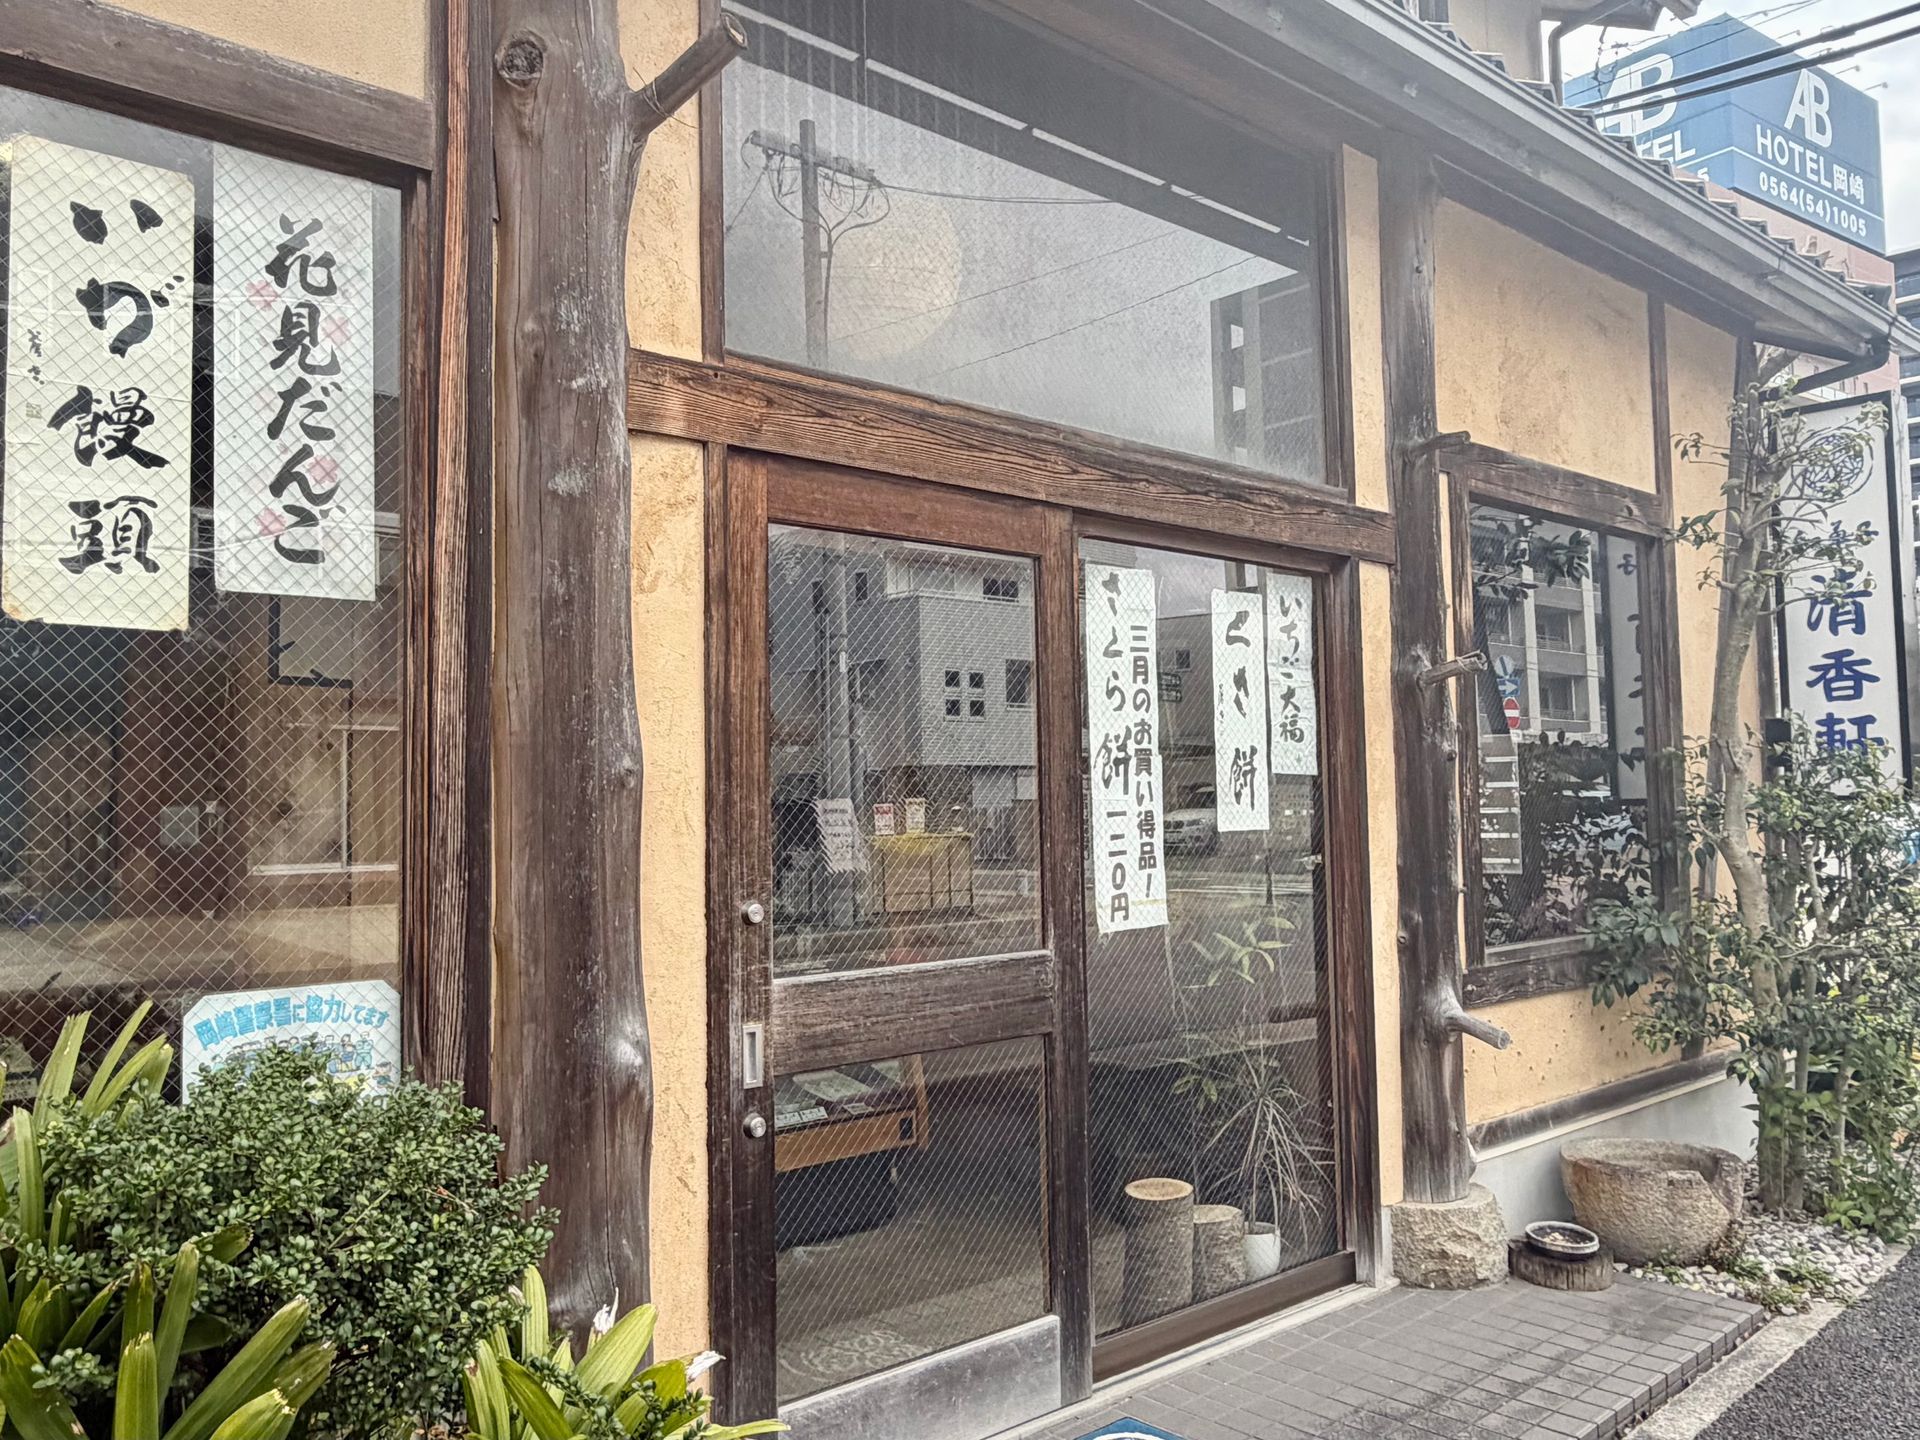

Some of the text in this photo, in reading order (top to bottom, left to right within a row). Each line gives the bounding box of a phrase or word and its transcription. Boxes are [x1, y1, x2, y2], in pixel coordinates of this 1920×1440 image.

[1637, 130, 1696, 164] TEL
[1784, 68, 1833, 148] AB
[1759, 171, 1867, 237] 0564(54)1005
[47, 198, 187, 576] いが饅頭
[264, 213, 348, 565] 花見だんご
[1279, 594, 1305, 744] いちご大福
[1806, 568, 1884, 757] 清香軒
